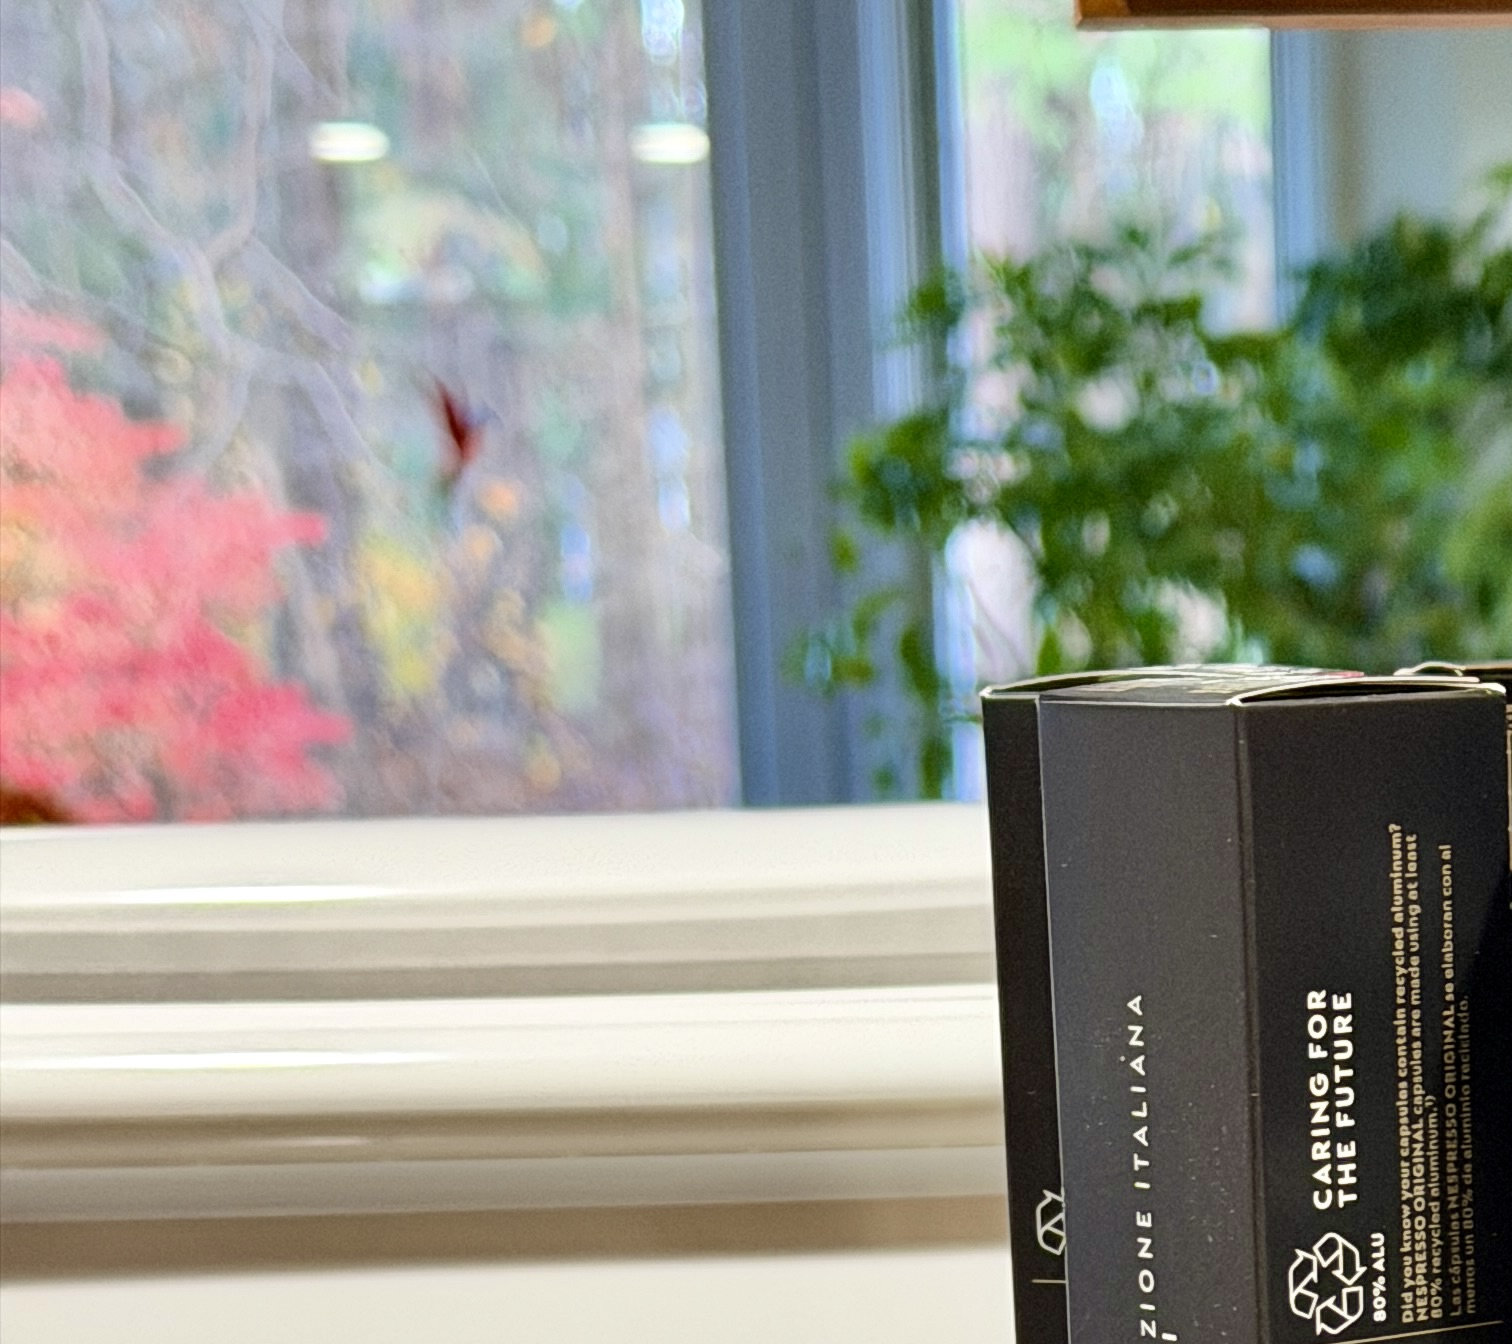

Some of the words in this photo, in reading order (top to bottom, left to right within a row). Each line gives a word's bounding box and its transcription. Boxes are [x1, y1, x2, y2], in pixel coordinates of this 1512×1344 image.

[1389, 824, 1403, 922] aluminum?
[1405, 835, 1417, 877] least
[1407, 882, 1418, 900] at
[1407, 905, 1422, 951] using
[1392, 927, 1408, 1004] recycled
[1406, 956, 1420, 1005] made
[1307, 990, 1328, 1058] FOR
[1393, 1008, 1407, 1077] contain
[1412, 1009, 1421, 1037] are
[1127, 996, 1150, 1188] ITALIANA
[1332, 993, 1355, 1127] FUTURE
[1410, 1041, 1425, 1114] capsules
[1309, 1073, 1333, 1209] CARING
[1396, 1081, 1411, 1156] capsules
[1337, 1141, 1357, 1208] THE
[1400, 1161, 1413, 1200] your
[1410, 1118, 1426, 1211] ORIGINAL
[1371, 1233, 1385, 1271] ALU
[1400, 1205, 1411, 1252] know
[1372, 1276, 1386, 1321] 80%
[1403, 1256, 1415, 1288] you
[1412, 1216, 1428, 1321] NESPRESSO
[1401, 1292, 1414, 1323] Did
